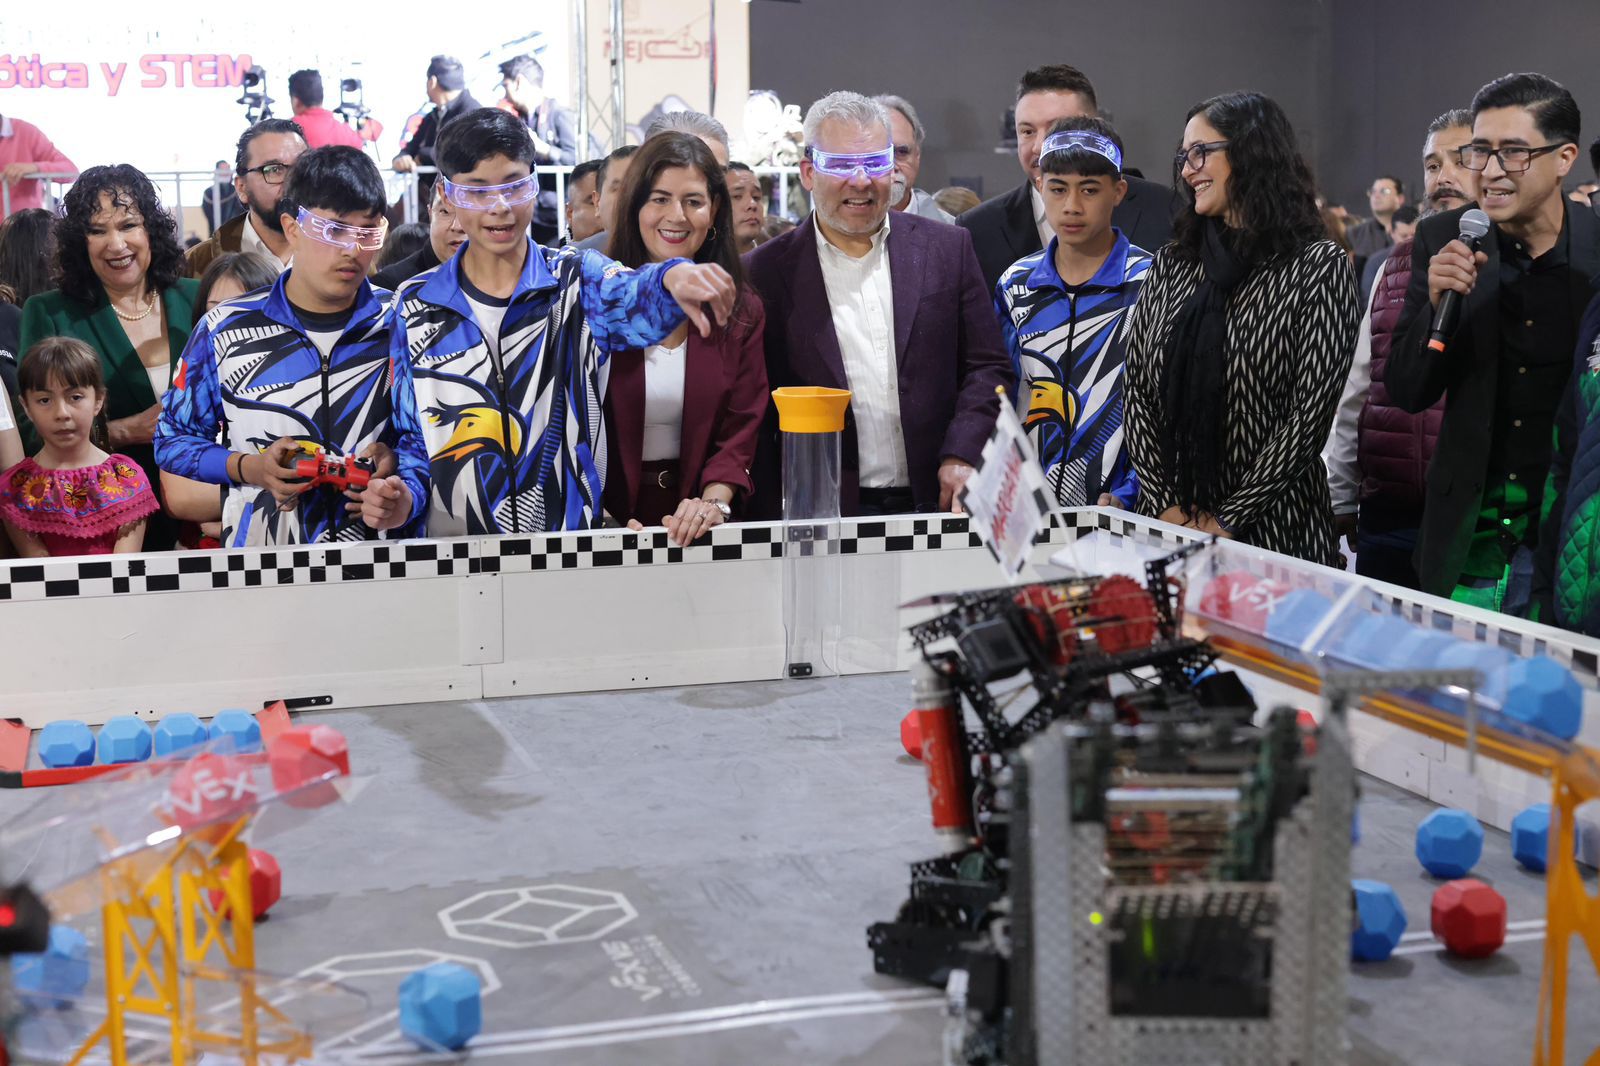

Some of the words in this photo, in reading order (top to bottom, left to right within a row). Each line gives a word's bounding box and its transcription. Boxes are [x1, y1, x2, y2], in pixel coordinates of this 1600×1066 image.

[99, 62, 127, 96] y
[139, 54, 252, 88] STEM
[1229, 578, 1286, 615] VEX
[163, 769, 258, 815] VEX
